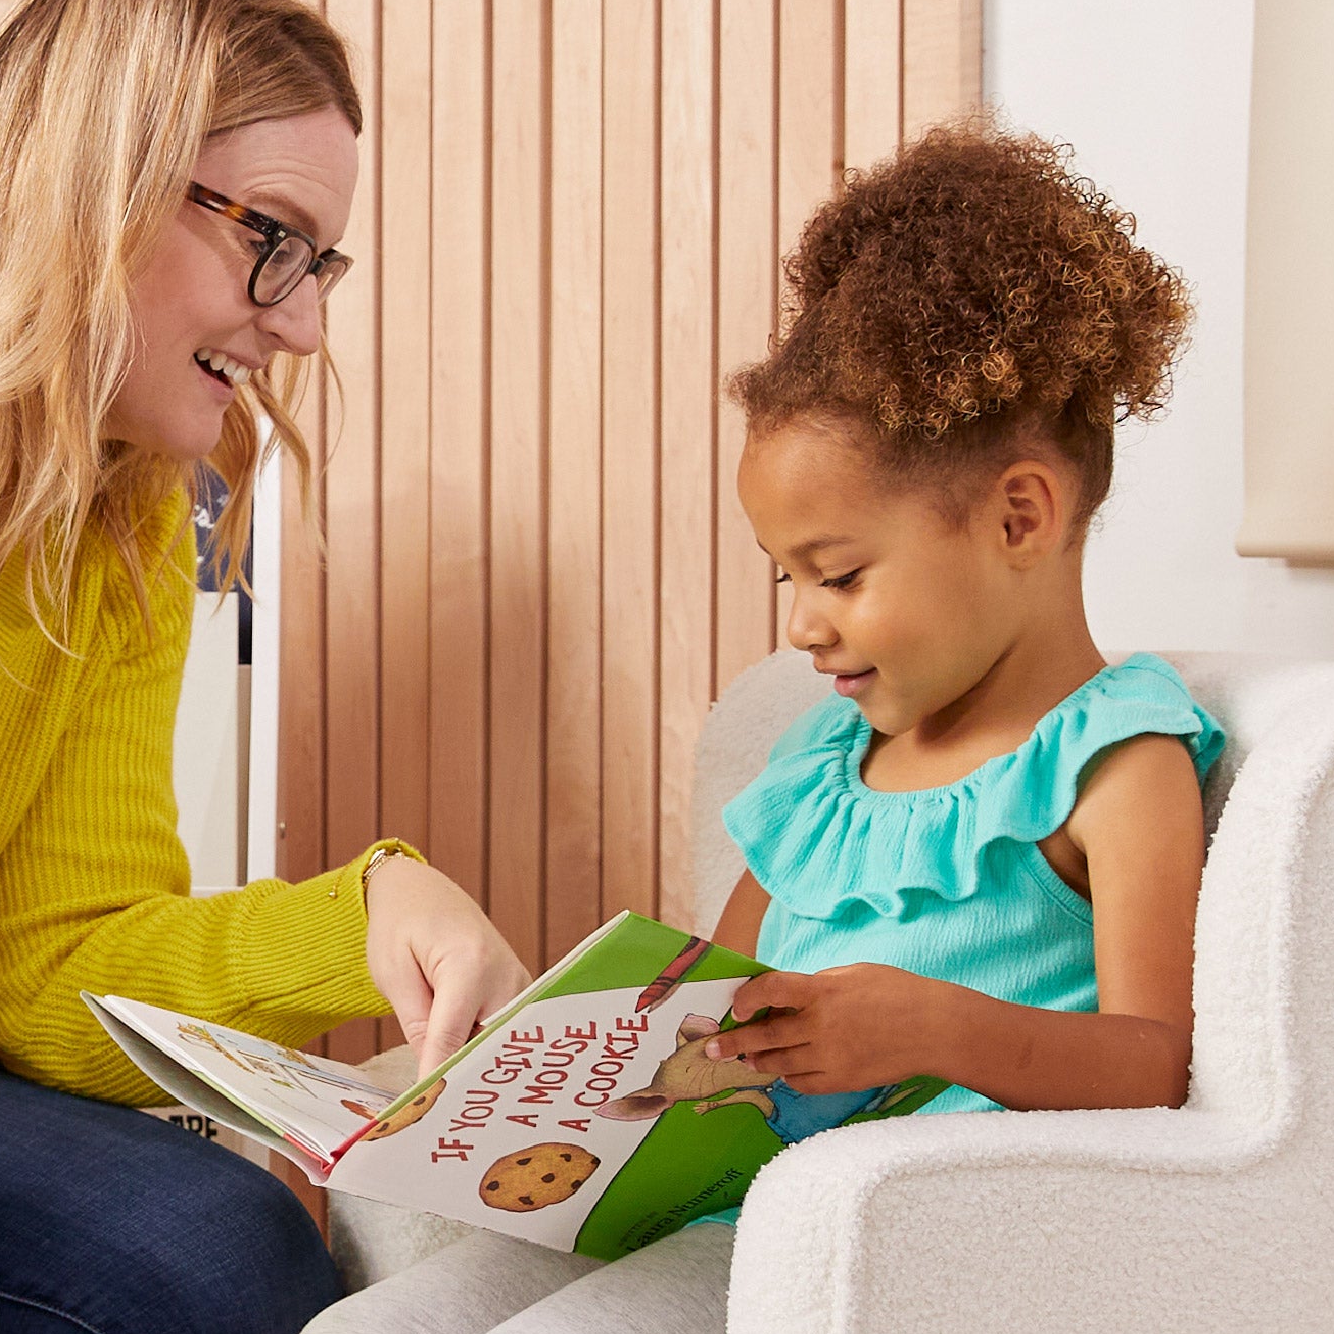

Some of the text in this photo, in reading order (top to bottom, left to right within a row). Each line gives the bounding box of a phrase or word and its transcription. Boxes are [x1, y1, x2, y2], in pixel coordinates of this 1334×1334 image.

[431, 1025, 546, 1164] IF YOU GIVE
[505, 1020, 597, 1128] A MOUSE
[557, 1013, 650, 1133] A COOKIE
